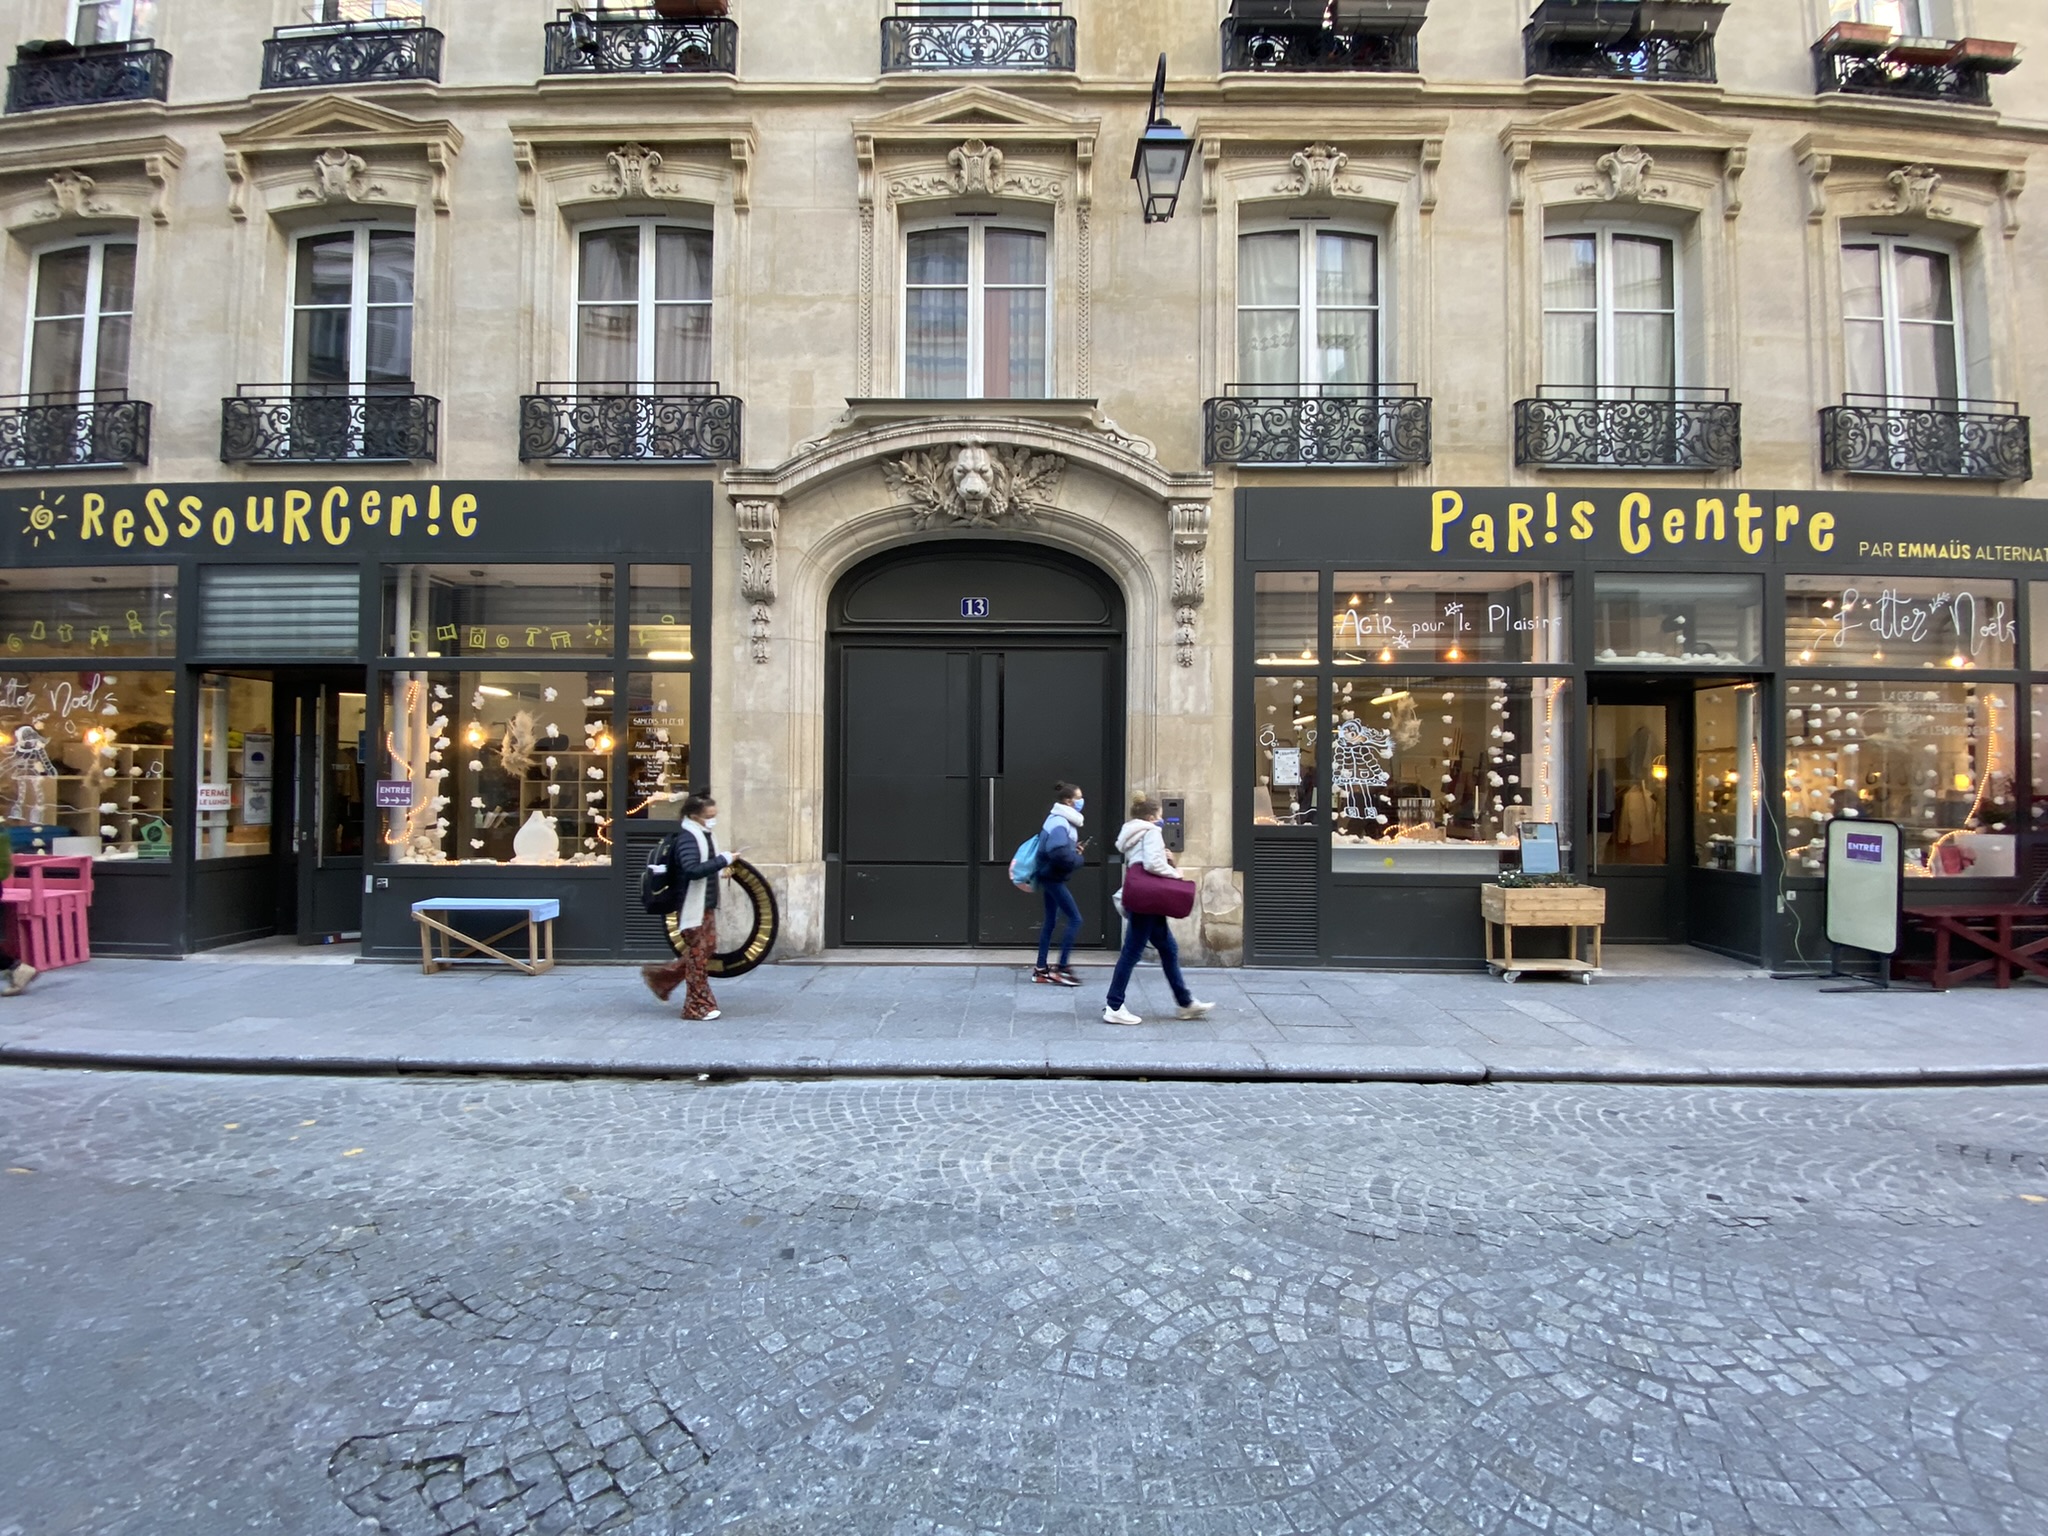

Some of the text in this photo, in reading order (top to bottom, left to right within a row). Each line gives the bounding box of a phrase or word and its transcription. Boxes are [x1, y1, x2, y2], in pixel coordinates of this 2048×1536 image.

[1620, 492, 1835, 555] Centre
[1859, 541, 1893, 557] PAR
[1898, 539, 1971, 560] EMMAÜS
[966, 599, 985, 615] 13
[1412, 621, 1445, 639] pour
[1459, 613, 1472, 631] le
[380, 786, 411, 794] ENTRÉE
[1848, 842, 1880, 853] ENTRÉE
